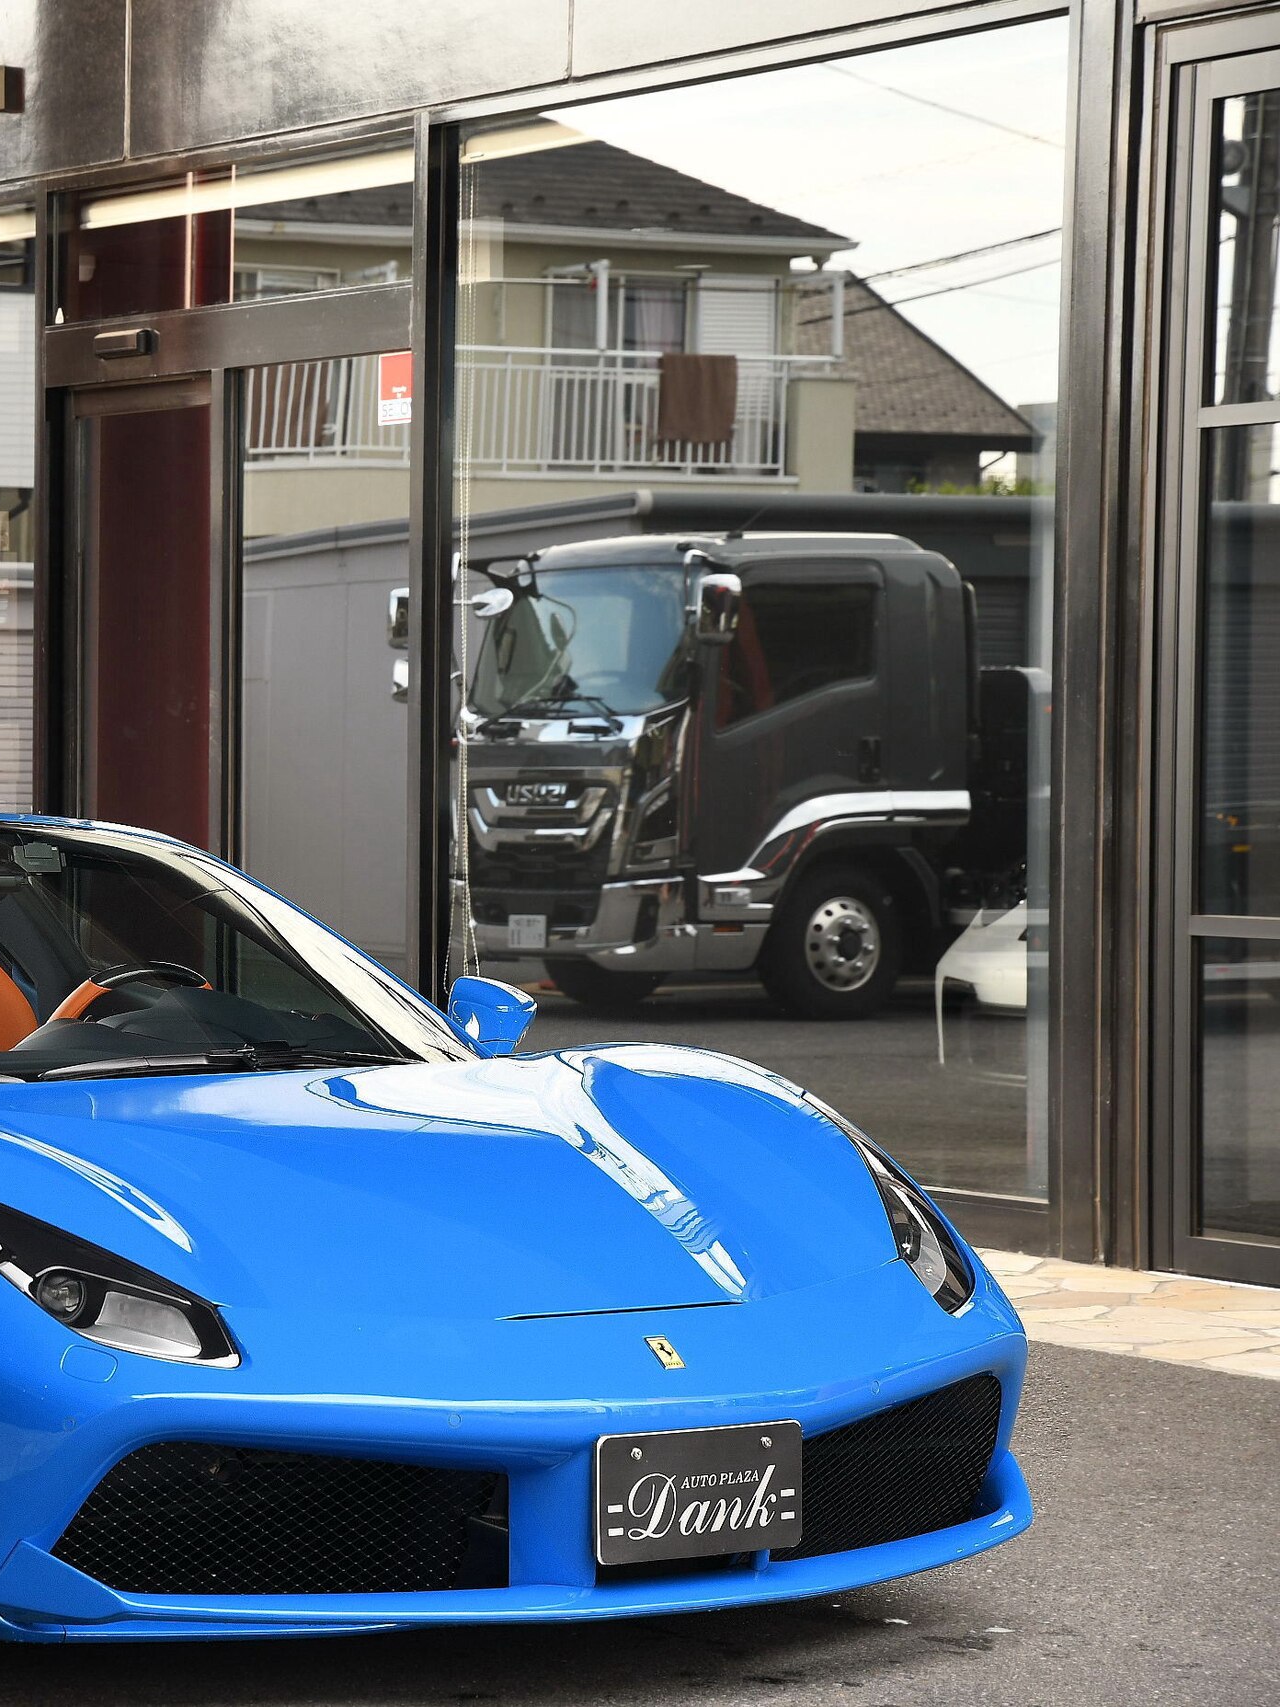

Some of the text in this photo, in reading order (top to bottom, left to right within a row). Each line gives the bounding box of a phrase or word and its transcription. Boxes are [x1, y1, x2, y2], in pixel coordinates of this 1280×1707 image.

[382, 402, 411, 417] SEO
[681, 1469, 760, 1490] AUTO PLAZA
[627, 1464, 778, 1541] Dank
